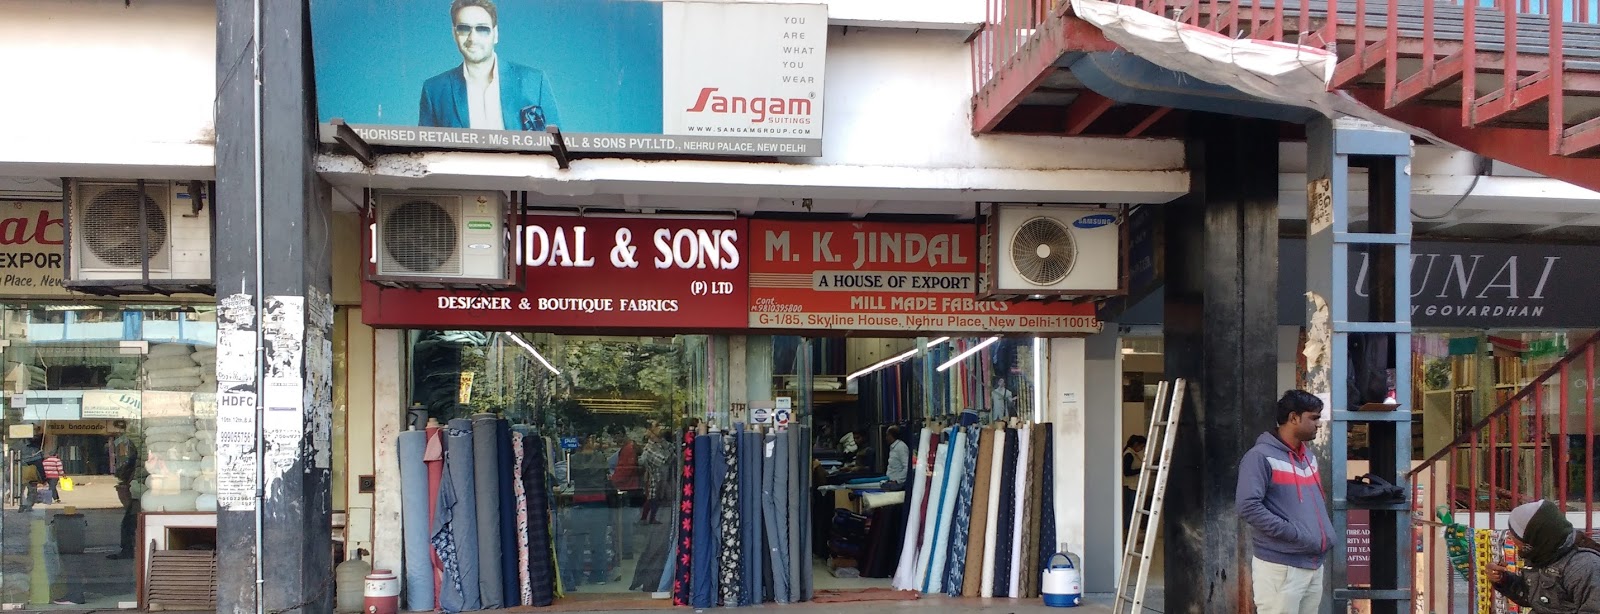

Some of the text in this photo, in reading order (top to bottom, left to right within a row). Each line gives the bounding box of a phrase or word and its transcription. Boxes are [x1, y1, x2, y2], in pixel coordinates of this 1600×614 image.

[784, 16, 806, 25] YOU
[783, 31, 806, 40] ARE
[782, 46, 815, 55] WHAT
[782, 61, 804, 69] YOU
[782, 75, 815, 84] WEAR
[686, 87, 812, 123] Sangam
[768, 117, 811, 125] SUITINGS
[687, 126, 811, 135] WWW.SANGAMGROUP.COM
[352, 128, 416, 141] THORISED
[419, 130, 479, 144] RETAILER
[488, 133, 509, 145] M/s
[512, 135, 579, 148] R.G.JINAL
[582, 137, 590, 148] &
[593, 137, 627, 149] SONS
[683, 141, 716, 151] NEHRU
[757, 143, 778, 153] NEW
[780, 144, 806, 153] DELHI
[1078, 217, 1111, 225] SAMSUNG
[610, 227, 639, 270] &
[654, 228, 740, 270] SONS
[765, 230, 800, 262] M.
[812, 231, 842, 262] K.
[852, 231, 967, 270] JINDAL
[690, 280, 734, 296] (P) LTD
[818, 275, 831, 288] A
[833, 275, 883, 289] HOUSE
[887, 276, 906, 289] OF
[912, 277, 971, 290] EXPORT
[438, 296, 679, 313] DESIGNER & BOUTIQUE FABRICS
[851, 296, 1009, 313] MILL MADE FABRICS
[1425, 304, 1545, 317] GOVARDHAN
[759, 314, 804, 327] G-1/85,
[808, 314, 854, 328] Skyline
[906, 315, 944, 328] Nehru
[989, 316, 1015, 328] New
[1019, 317, 1098, 328] Delhi-110019
[222, 395, 254, 406] HDFC
